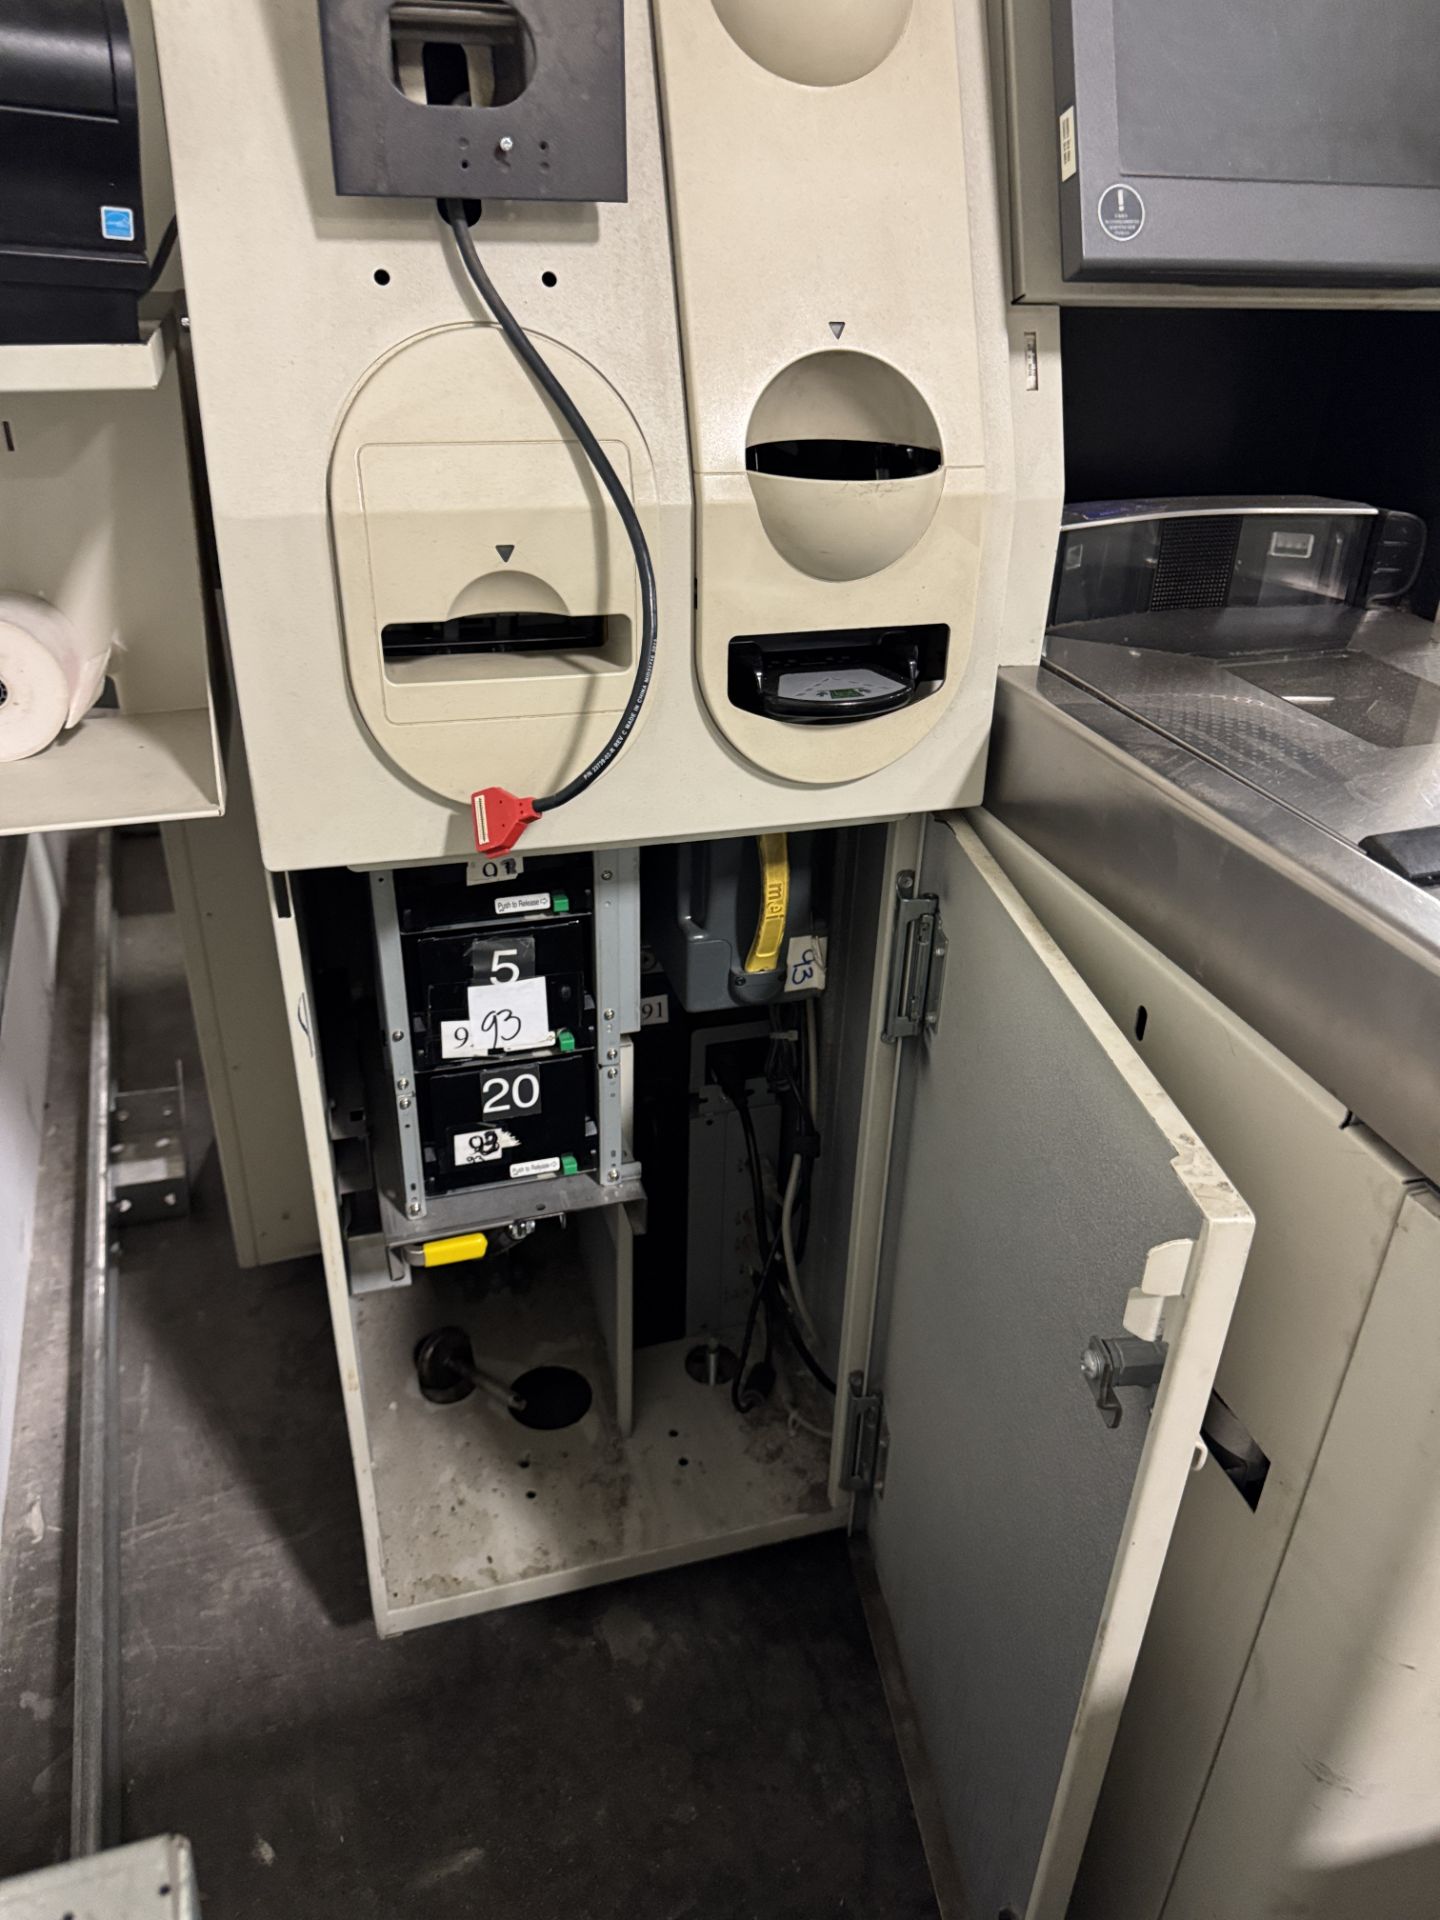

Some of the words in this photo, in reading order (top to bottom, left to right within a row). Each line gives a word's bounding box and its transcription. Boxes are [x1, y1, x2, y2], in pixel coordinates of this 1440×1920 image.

[636, 685, 647, 704] CHINA
[633, 704, 640, 712] IN
[625, 712, 637, 730] MADE
[613, 735, 624, 748] REV
[497, 902, 511, 912] Push
[518, 899, 540, 908] Release
[765, 882, 785, 920] mei
[489, 948, 520, 985] 5
[791, 949, 815, 985] 93
[641, 1001, 663, 1019] 91
[481, 1008, 522, 1049] 93
[482, 1073, 540, 1114] 20
